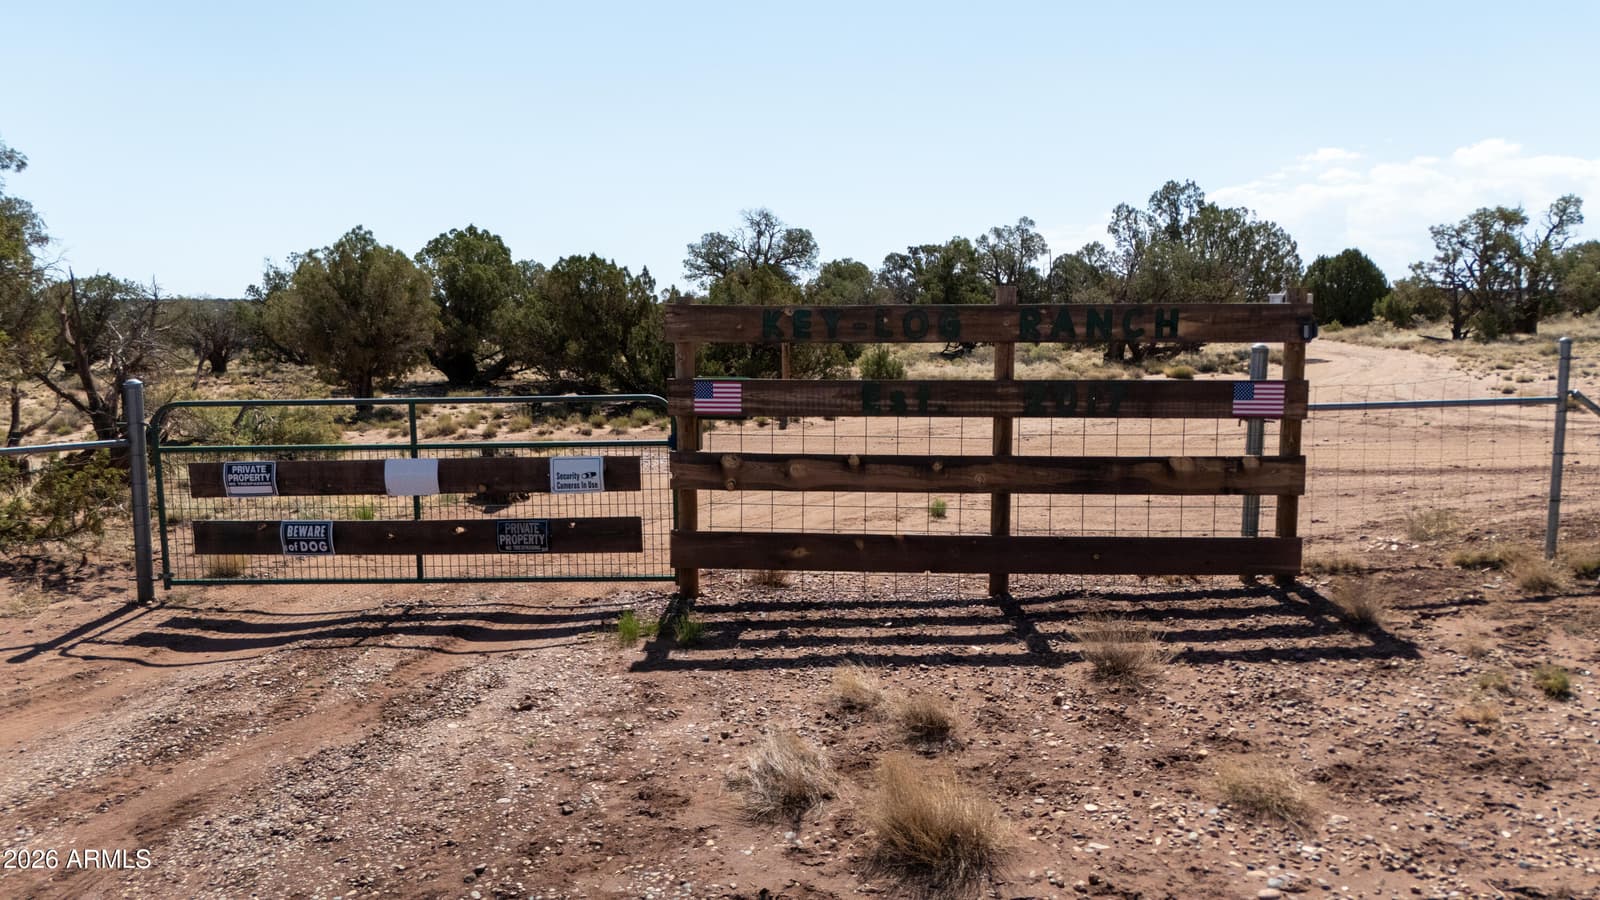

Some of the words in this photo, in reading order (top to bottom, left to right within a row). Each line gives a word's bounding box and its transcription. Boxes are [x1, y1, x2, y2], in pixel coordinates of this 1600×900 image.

[763, 308, 961, 340] KEY-LOG
[1020, 307, 1179, 341] RANCH
[232, 465, 267, 473] PRIVATE
[228, 473, 271, 482] PROPERTY
[556, 472, 580, 481] Security
[556, 482, 580, 490] Cameras
[581, 481, 587, 489] In
[588, 481, 598, 489] Use
[287, 525, 326, 538] BEWARE
[505, 522, 540, 534] PRIVATE
[500, 534, 545, 545] PROPERTY
[288, 542, 298, 552] of
[300, 541, 328, 552] DOG
